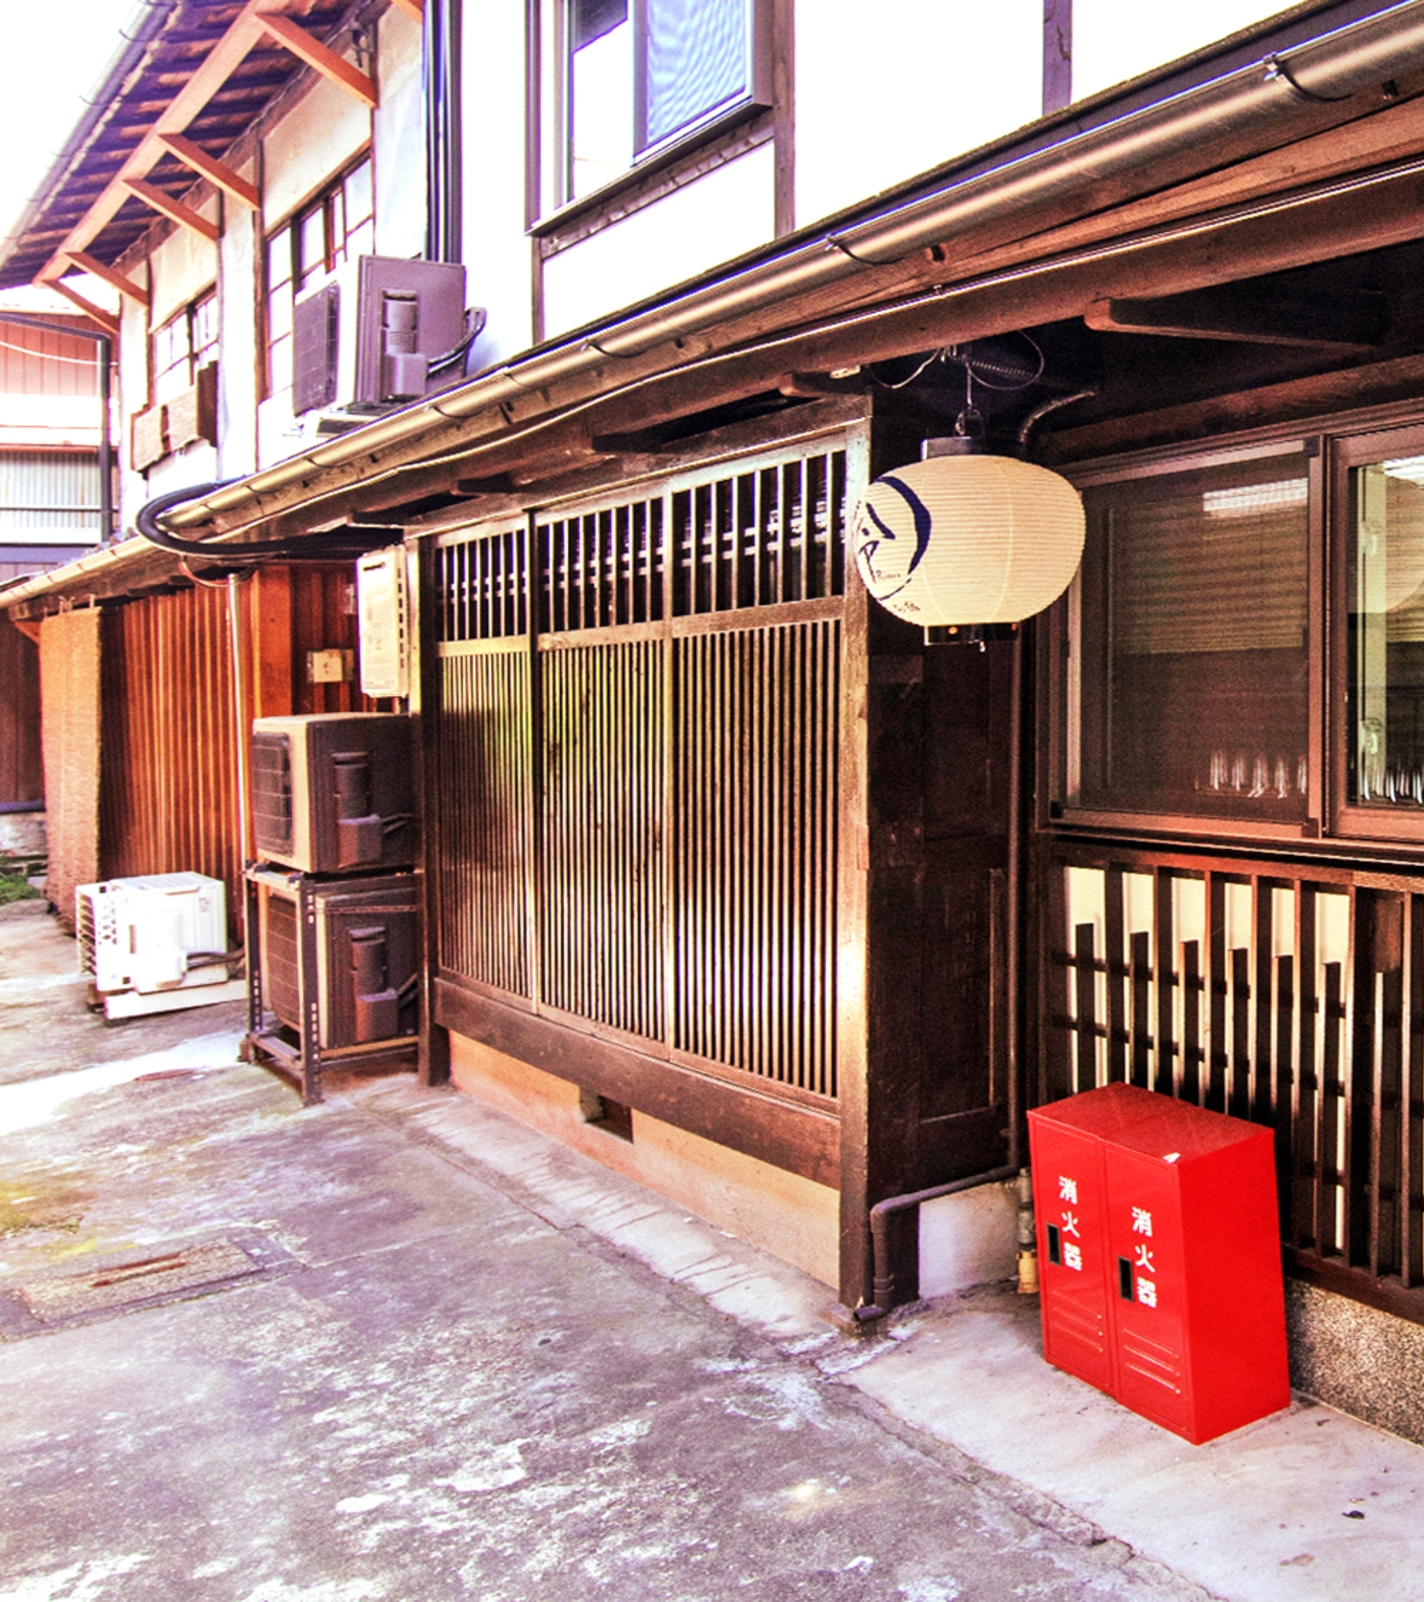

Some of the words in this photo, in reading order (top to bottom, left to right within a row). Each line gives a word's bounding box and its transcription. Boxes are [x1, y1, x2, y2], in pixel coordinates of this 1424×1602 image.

[1058, 1175, 1083, 1272] 消火器
[1131, 1206, 1157, 1309] 消火器
